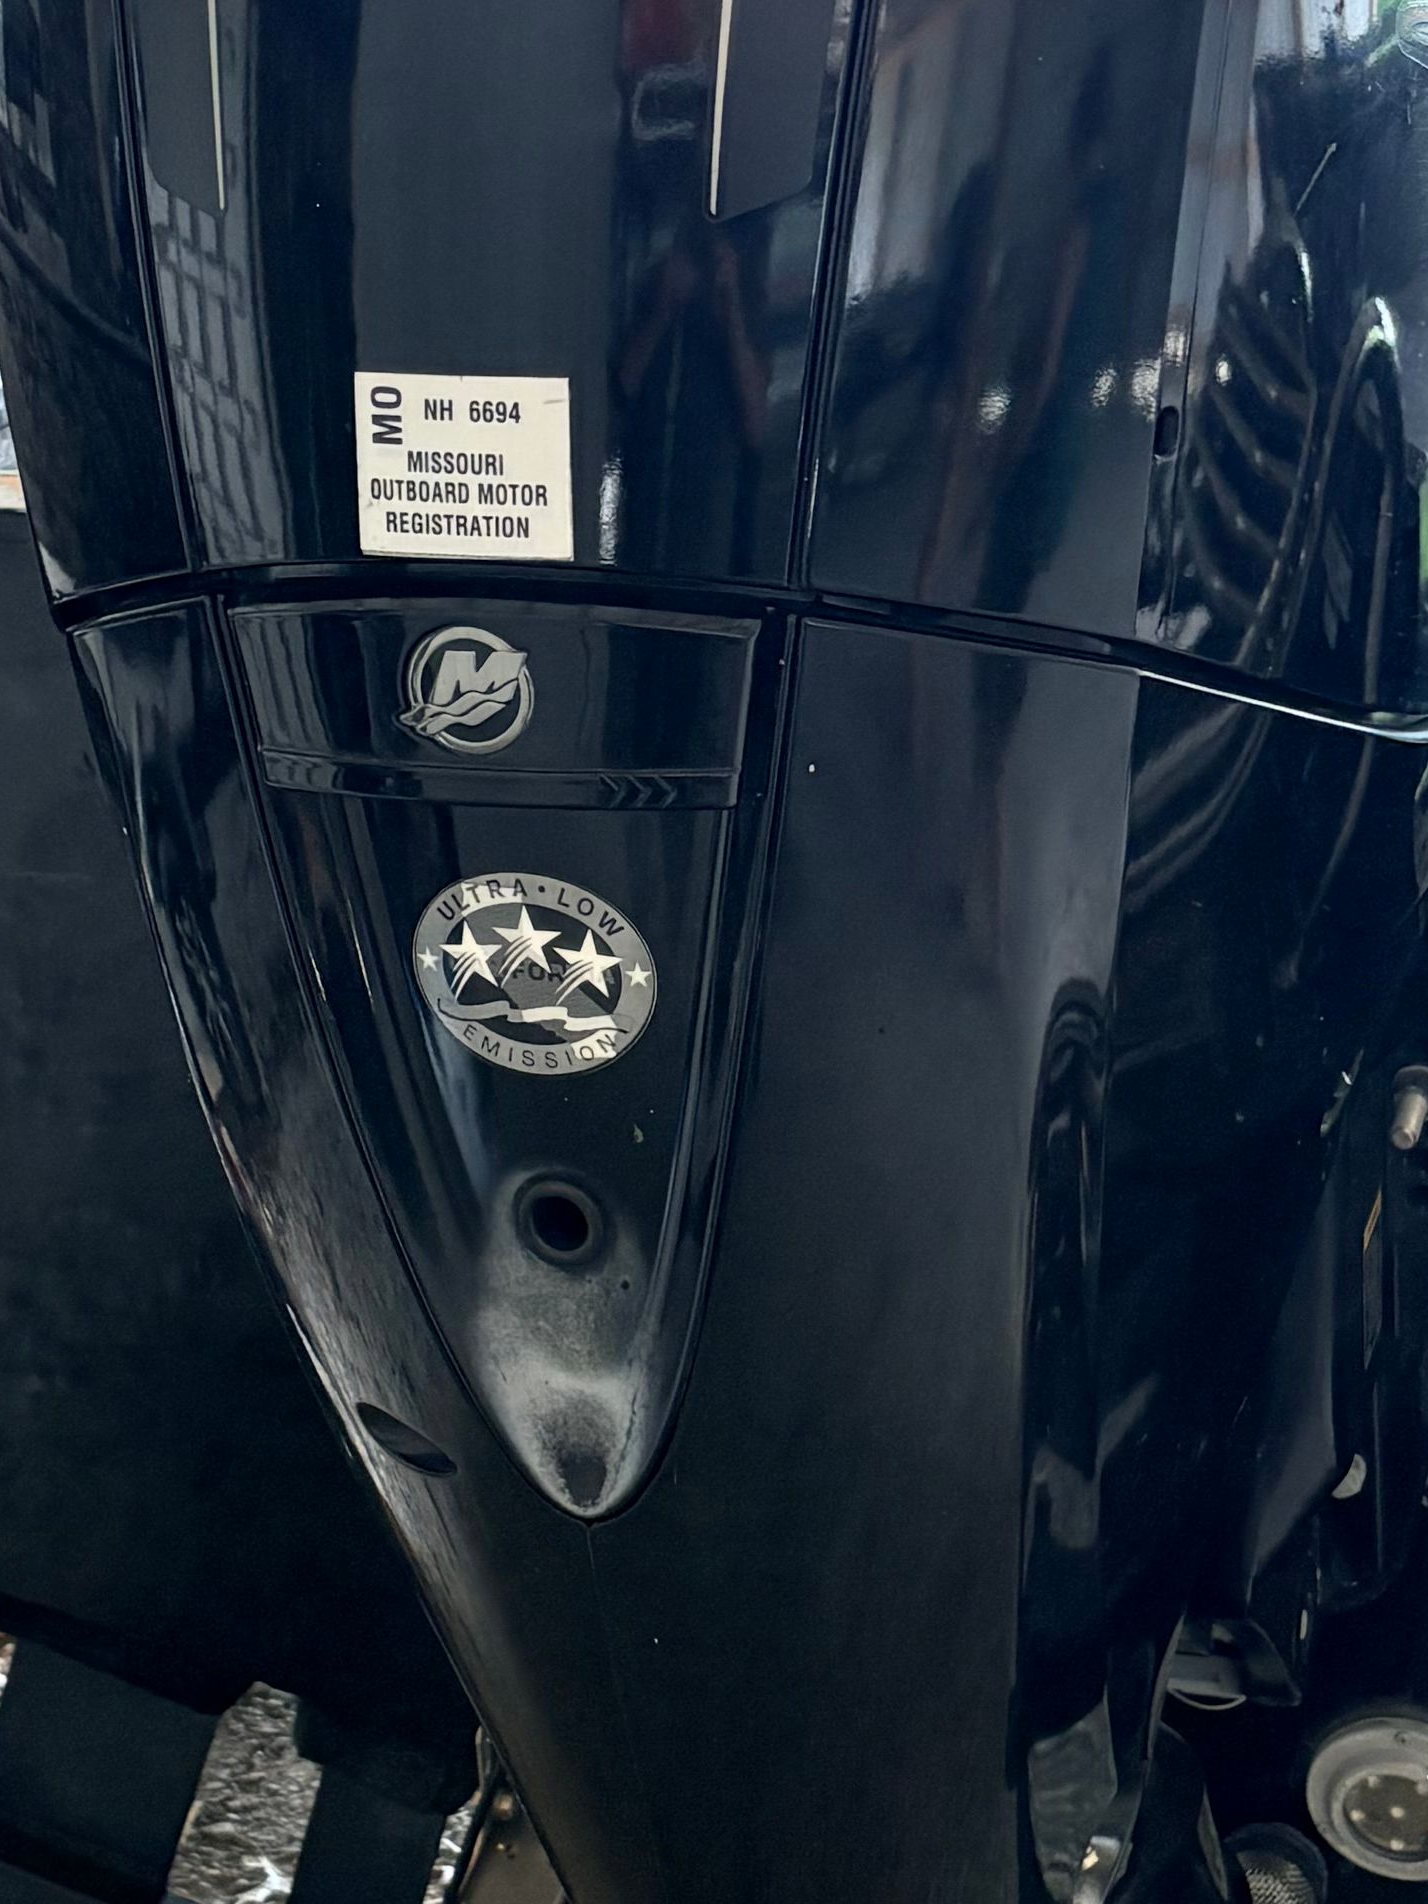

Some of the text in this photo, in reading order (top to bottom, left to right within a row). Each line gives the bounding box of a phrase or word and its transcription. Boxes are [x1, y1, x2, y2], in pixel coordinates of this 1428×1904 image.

[370, 385, 403, 446] MO
[424, 398, 521, 424] NH 6694
[407, 450, 504, 476] MISSOURI
[370, 478, 548, 507] OUTBOARD MOTOR
[385, 511, 530, 538] REGISTRATION
[436, 878, 625, 937] ULTRA LOW
[463, 1023, 618, 1069] EMISSION
